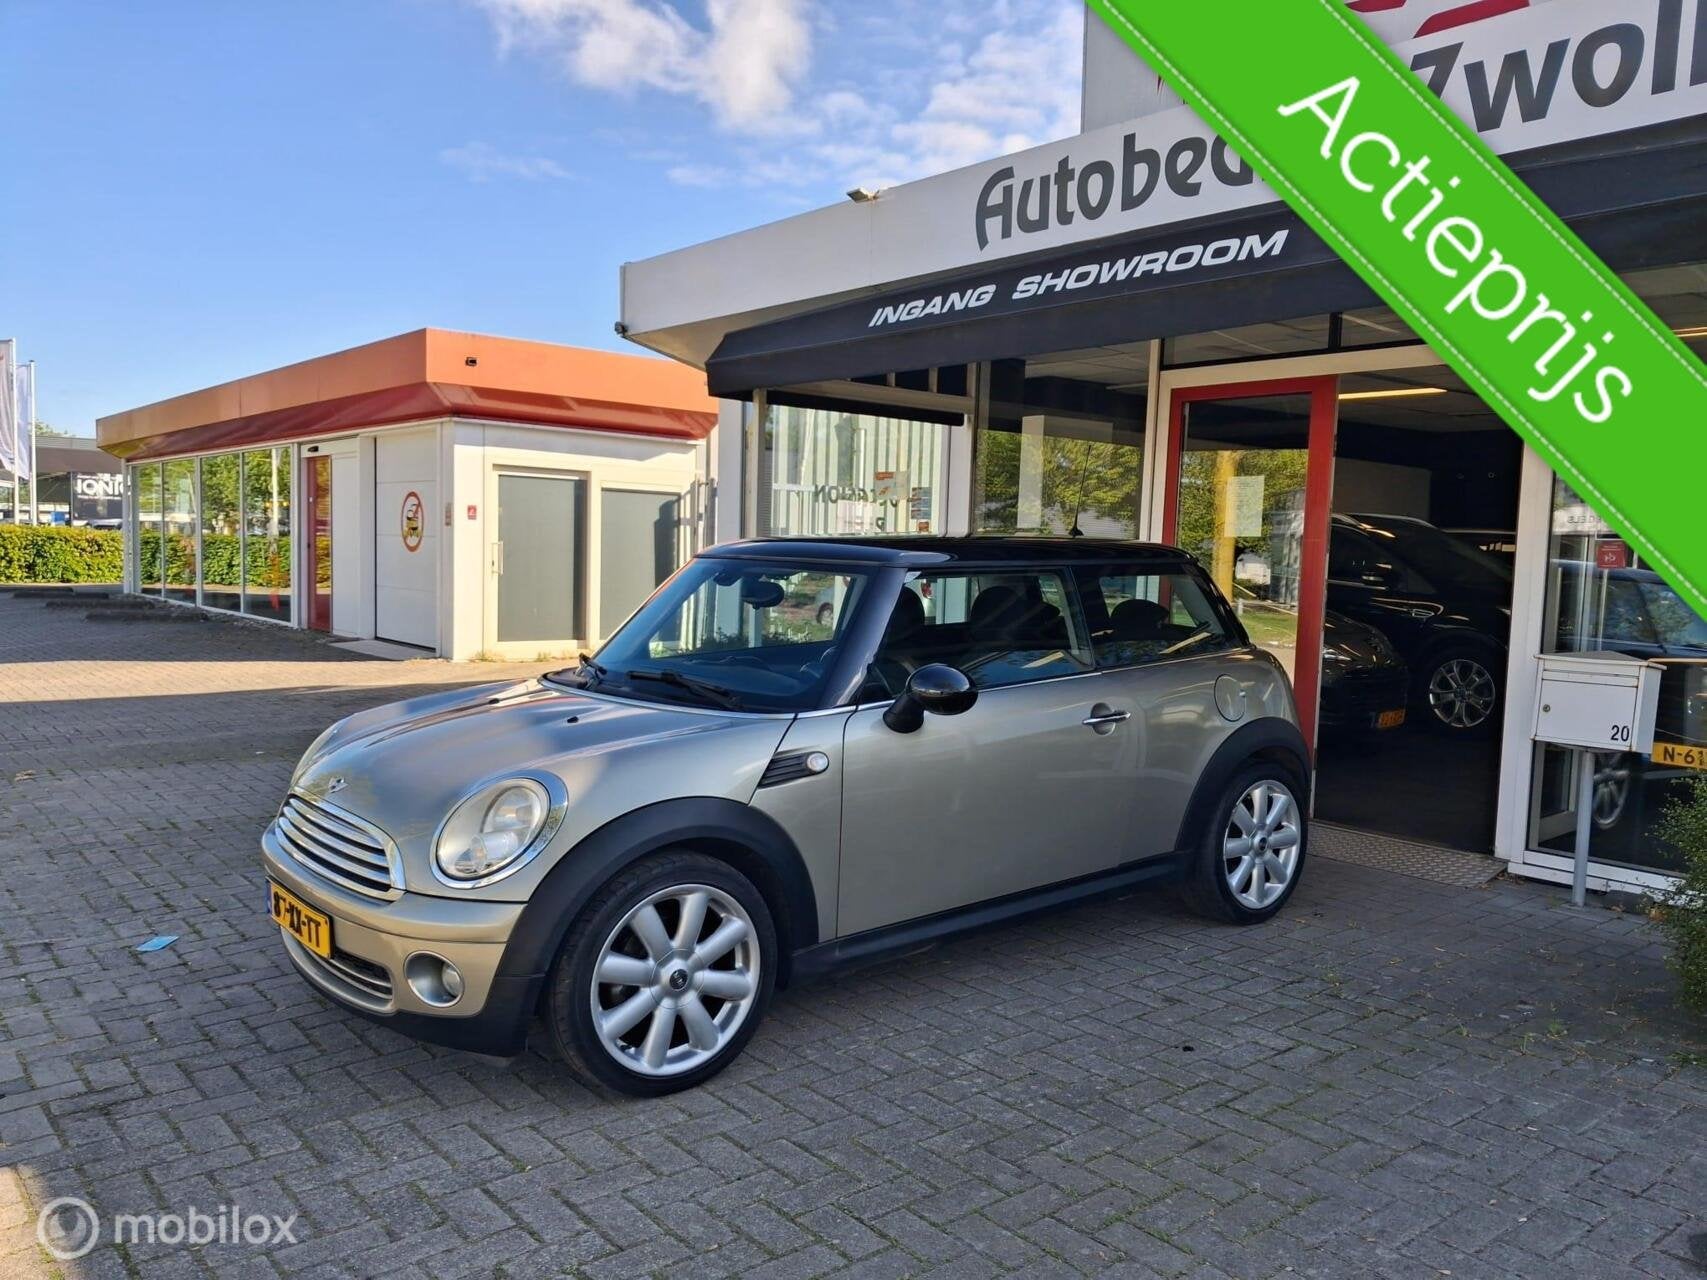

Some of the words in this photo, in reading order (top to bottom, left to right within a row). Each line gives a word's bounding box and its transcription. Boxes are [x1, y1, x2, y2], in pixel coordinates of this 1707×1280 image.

[868, 284, 996, 328] INGANG
[1012, 229, 1289, 300] SHOWROOM
[1611, 724, 1630, 742] 20
